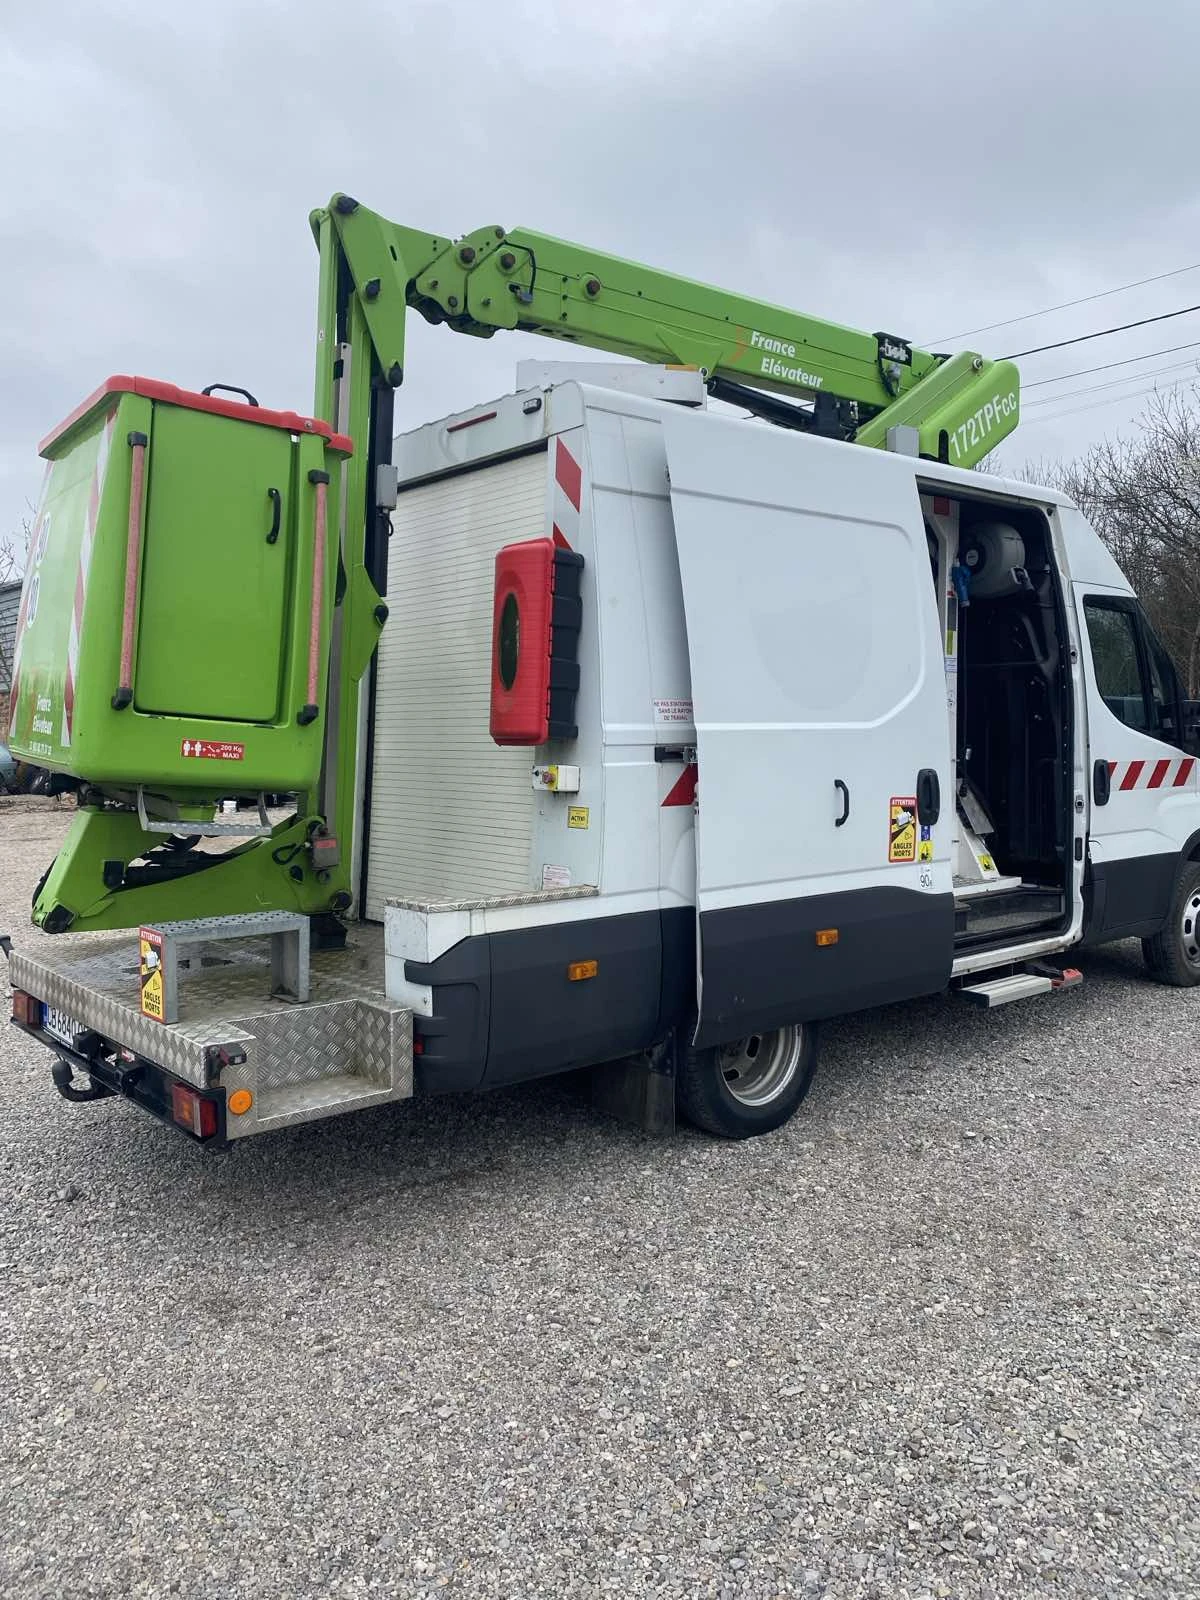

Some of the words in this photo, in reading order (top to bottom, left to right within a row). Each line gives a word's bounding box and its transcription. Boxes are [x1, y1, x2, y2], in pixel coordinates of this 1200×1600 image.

[750, 331, 796, 358] France
[761, 357, 823, 388] Elévateur
[893, 849, 911, 857] MORTS
[141, 930, 161, 945] ATTENTION
[144, 990, 161, 1005] ANGLES
[144, 1001, 161, 1016] MORTS
